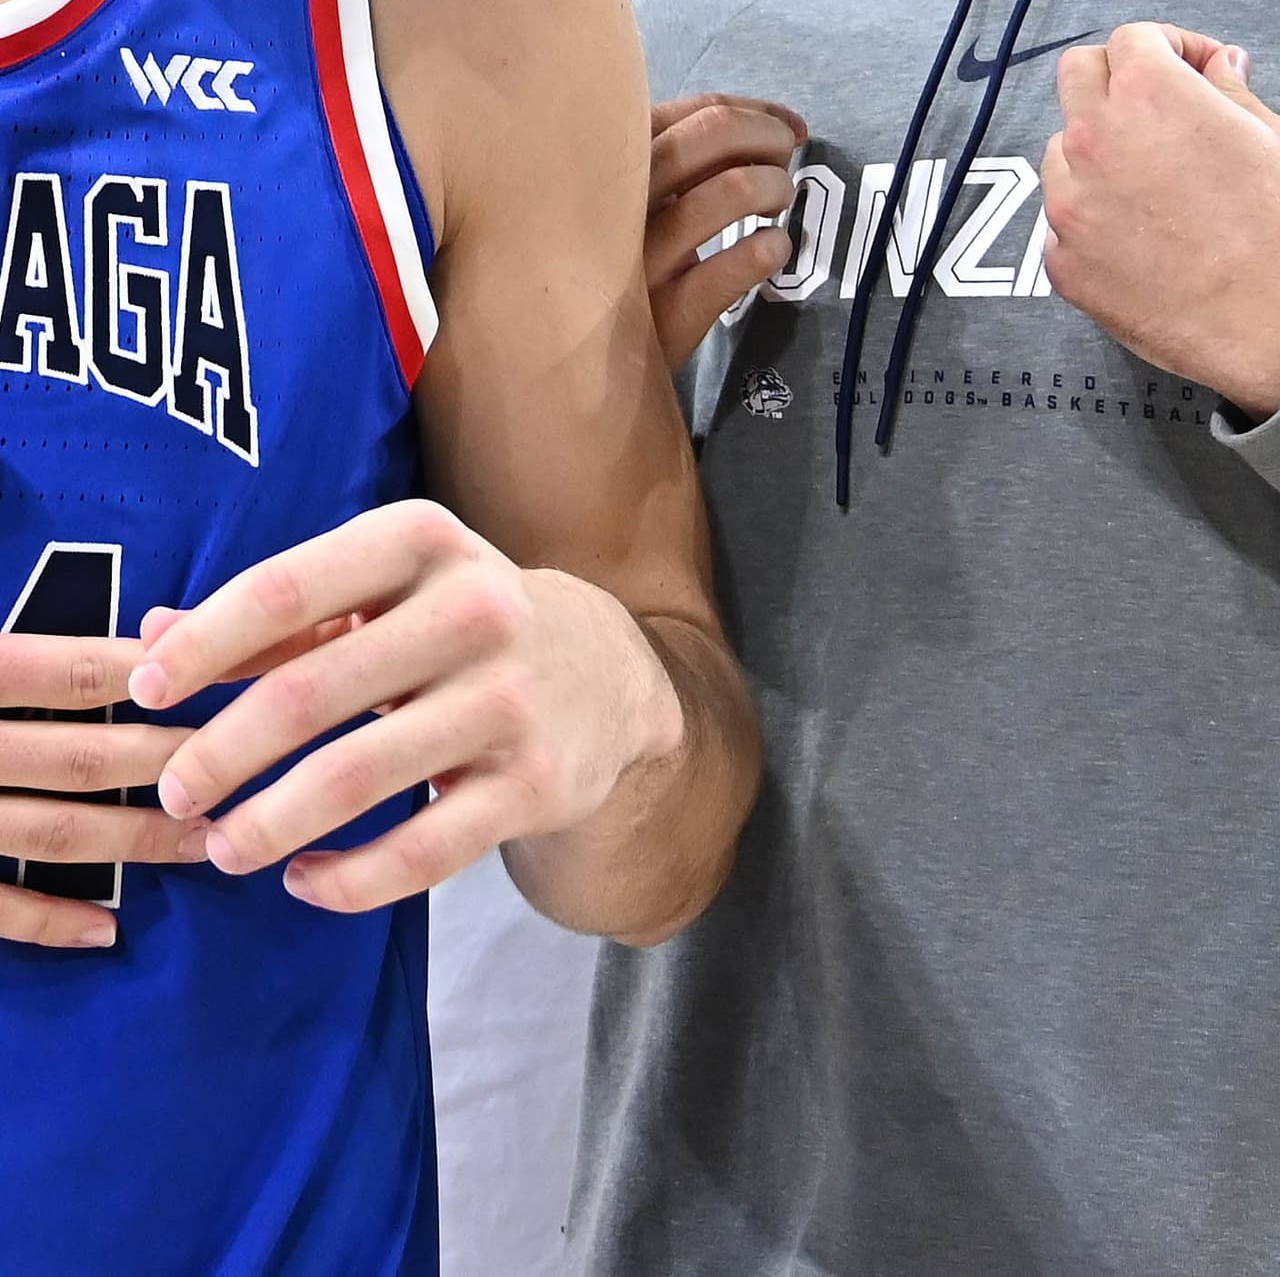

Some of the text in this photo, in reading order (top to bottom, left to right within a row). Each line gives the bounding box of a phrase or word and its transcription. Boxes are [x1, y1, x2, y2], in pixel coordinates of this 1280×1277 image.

[120, 47, 258, 113] WCC
[832, 370, 1194, 402] ENINEERED FO
[1001, 392, 1207, 426] BASKETBAL
